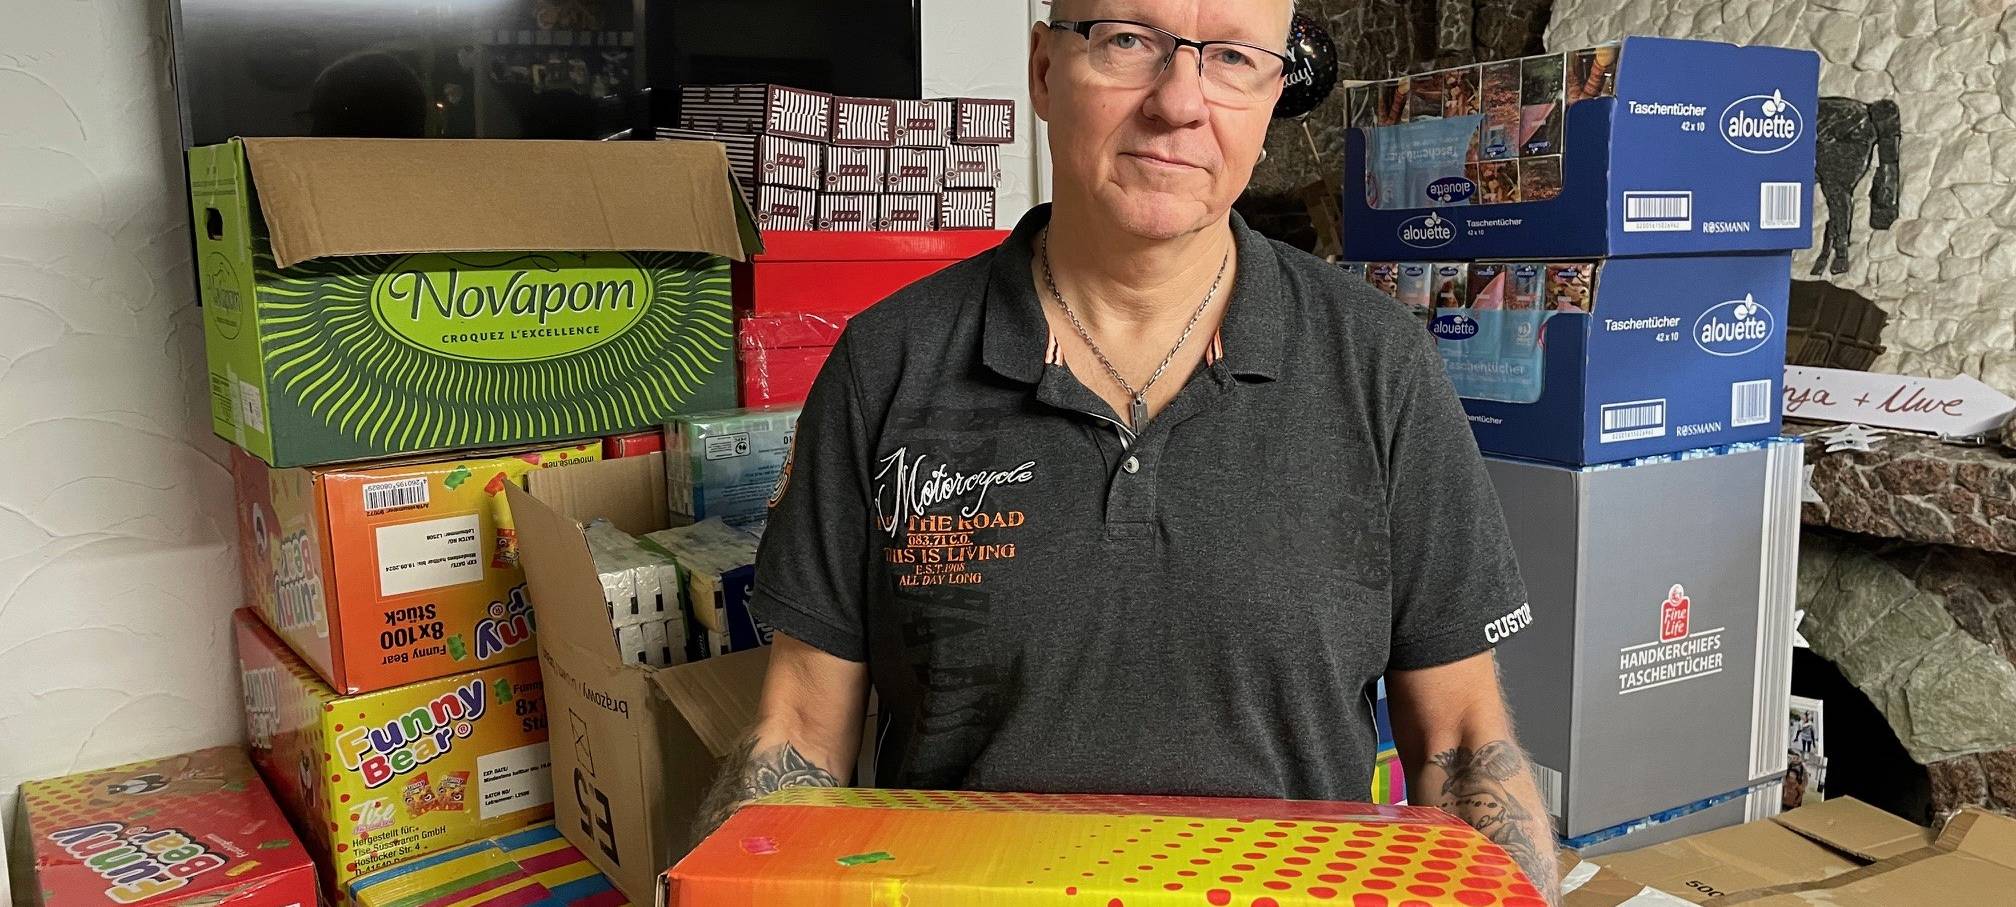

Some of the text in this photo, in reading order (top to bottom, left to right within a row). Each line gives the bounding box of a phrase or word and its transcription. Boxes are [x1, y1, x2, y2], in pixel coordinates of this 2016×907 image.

[1629, 101, 1707, 116] Taschentücher
[1681, 121, 1691, 131] 42
[1697, 122, 1705, 132] 10
[1728, 110, 1795, 139] alouette
[1430, 181, 1472, 196] alouette
[1403, 223, 1451, 241] alouette
[1466, 218, 1522, 229] Taschentücher
[1703, 221, 1751, 234] ROSSMANN
[389, 268, 635, 325] Novapom
[1433, 320, 1475, 335] alouette
[1605, 316, 1681, 332] Taschentücher
[1701, 317, 1766, 343] alouette
[442, 325, 600, 344] CROQUEZ L'EXCELLENCE
[1656, 333, 1665, 342] 42
[1671, 332, 1679, 342] 10
[1784, 384, 1837, 412] nja
[1876, 385, 1964, 416] Uwe
[1676, 422, 1722, 437] ROSSMANN
[875, 447, 1036, 538] Motorcycle
[908, 514, 952, 532] THE
[958, 511, 1024, 531] ROAD
[921, 548, 941, 563] IS
[947, 543, 1016, 562] LIVING
[900, 573, 982, 586] ALL DAY LONG
[384, 603, 437, 627] Stück
[1664, 607, 1686, 624] Fine
[380, 621, 444, 650] 8x100
[1665, 621, 1684, 637] Life
[382, 644, 447, 665] Funny Bear
[1620, 634, 1721, 670] HANDKERCHIEFS
[1619, 652, 1723, 690] TASCHENTÜCHER
[336, 678, 487, 771] Funny
[359, 725, 455, 788] Bear
[352, 829, 399, 848] Hergestellt
[353, 846, 371, 858] Tise
[421, 825, 447, 839] GmbH
[49, 822, 190, 904] Funny
[127, 827, 229, 880] Bear
